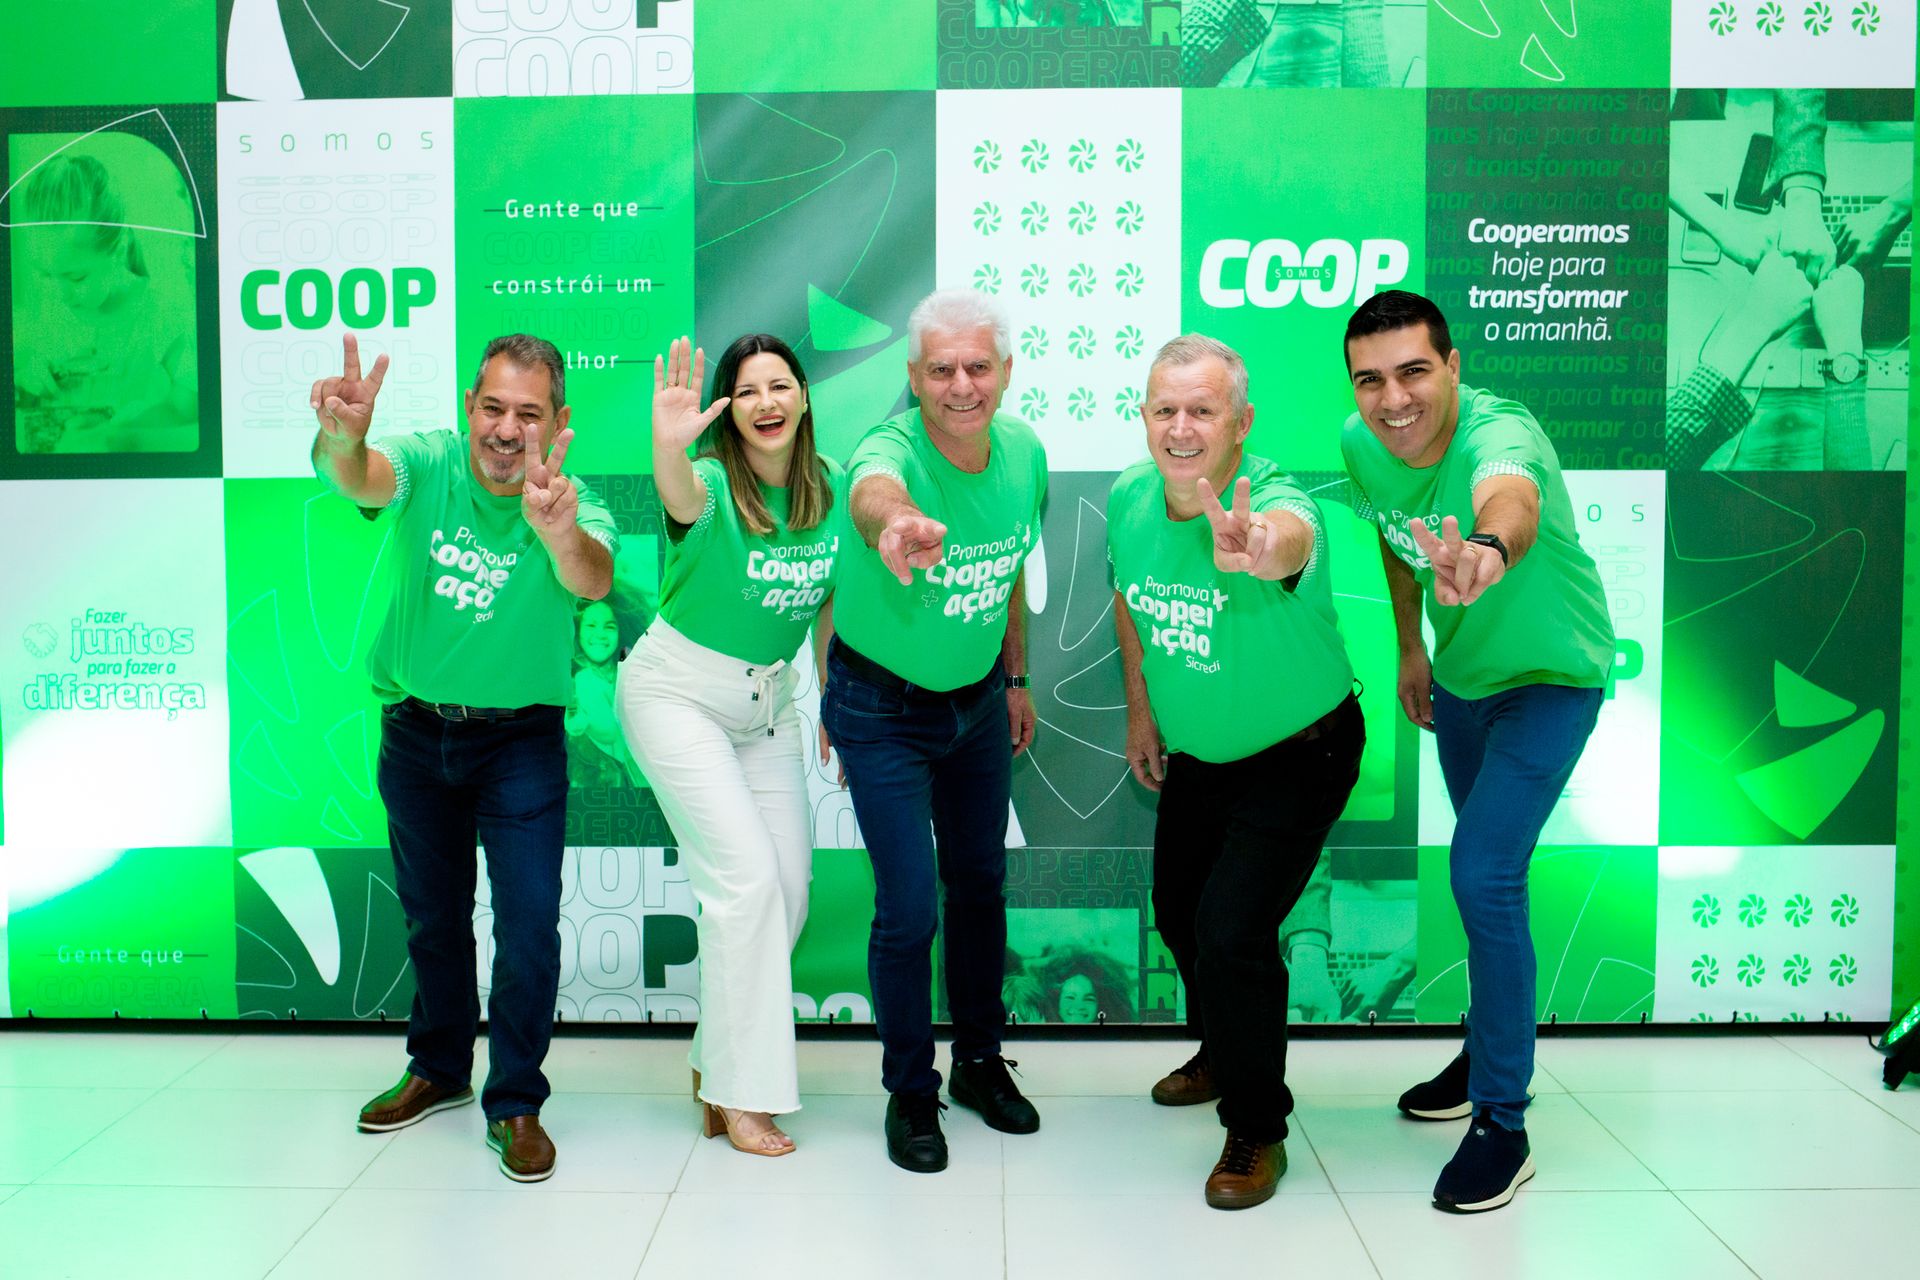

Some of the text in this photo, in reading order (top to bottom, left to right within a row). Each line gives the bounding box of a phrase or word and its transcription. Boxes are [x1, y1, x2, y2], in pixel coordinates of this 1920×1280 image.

[505, 199, 638, 221] Gente que
[1468, 218, 1630, 249] Cooperamos
[1199, 238, 1410, 308] COOP
[1274, 268, 1332, 279] SOMOS
[1492, 251, 1606, 282] hoje para
[493, 274, 652, 294] constrói um
[240, 267, 437, 330] COOP
[1468, 283, 1629, 314] transformar
[1485, 316, 1612, 341] o amanhã.
[948, 535, 1017, 561] Promova
[761, 581, 825, 615] ação
[943, 579, 1011, 624] ação
[1144, 575, 1209, 603] Promova
[85, 608, 127, 624] Fazer
[70, 618, 195, 664] juntos
[87, 659, 177, 678] para fazer a
[1185, 654, 1221, 674] Sicredi
[23, 673, 206, 721] diferença
[141, 949, 184, 968] que
